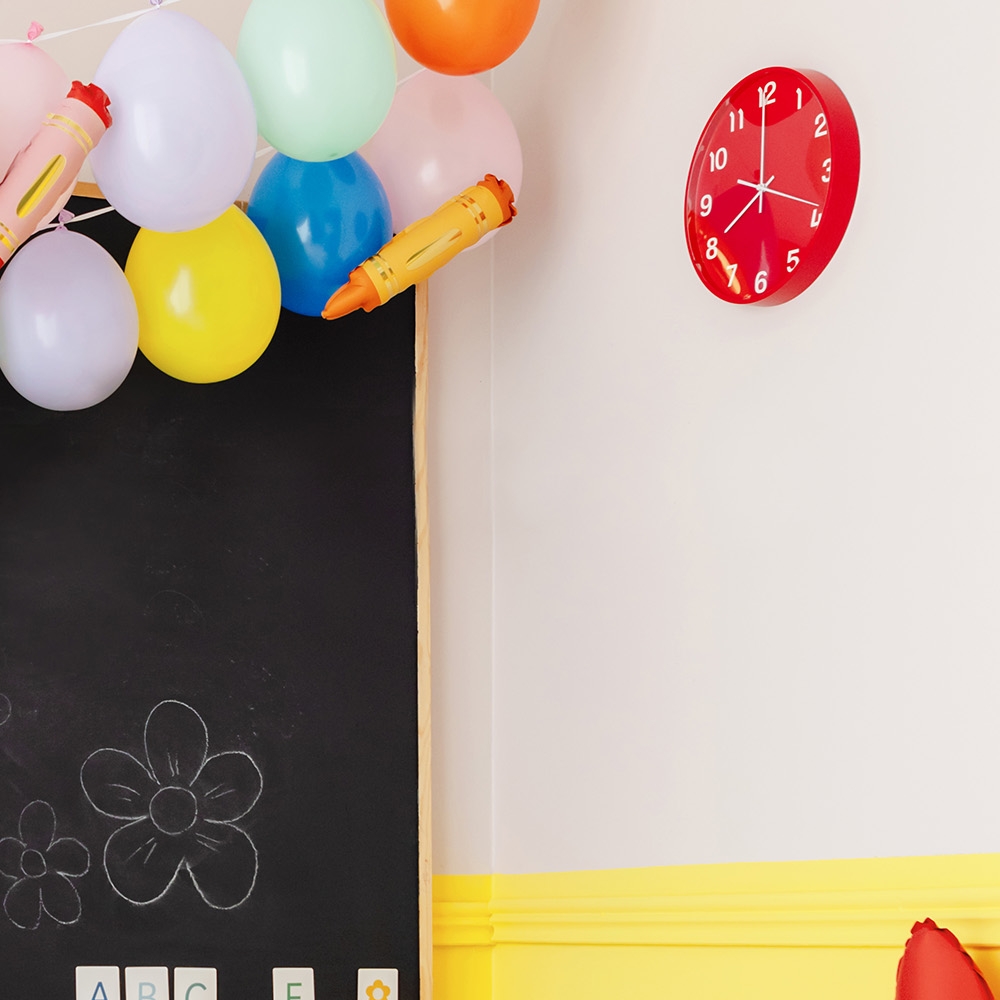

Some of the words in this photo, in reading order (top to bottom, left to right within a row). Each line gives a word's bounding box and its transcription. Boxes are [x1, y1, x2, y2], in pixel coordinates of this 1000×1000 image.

[757, 80, 777, 108] 12
[796, 87, 803, 110] 1
[729, 108, 744, 132] 11
[814, 113, 828, 138] 2
[709, 147, 728, 172] 10
[821, 158, 832, 183] 3
[700, 194, 713, 217] 9
[705, 237, 718, 260] 8
[786, 248, 800, 273] 5
[726, 264, 738, 288] 7
[754, 271, 768, 294] 6
